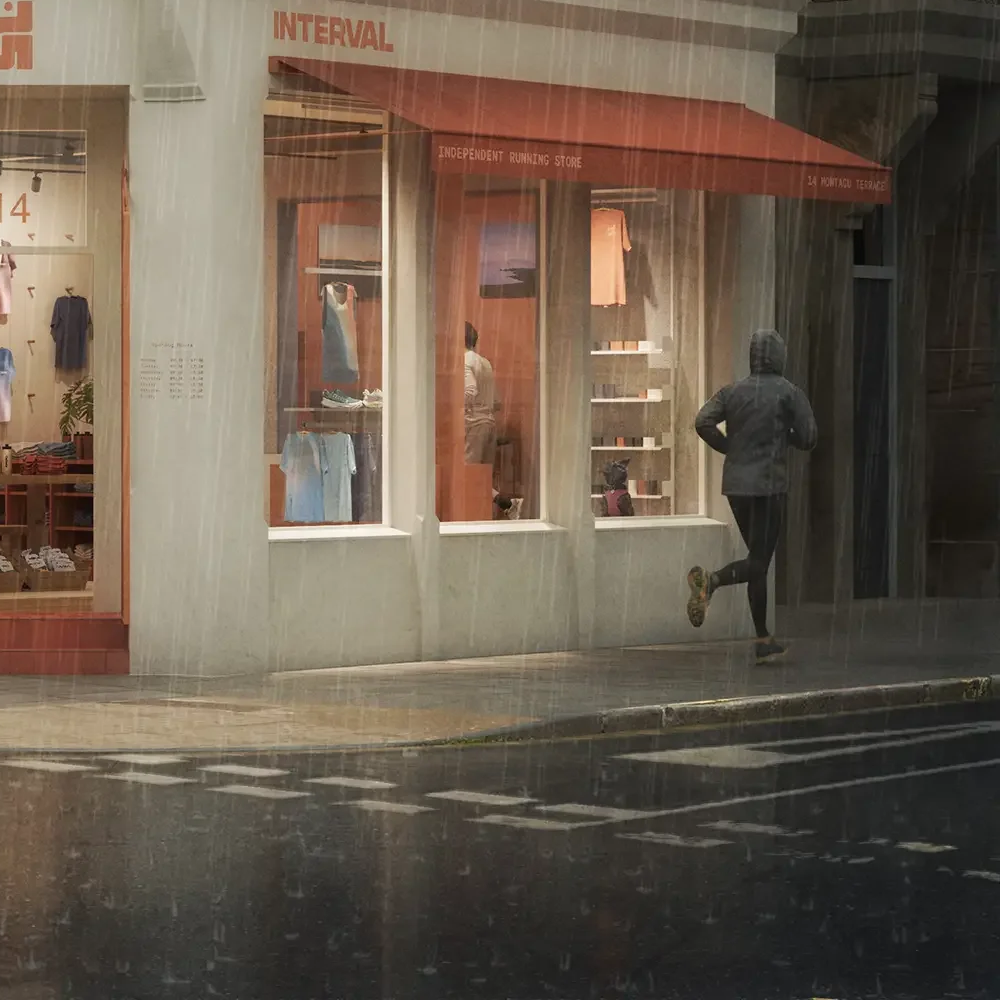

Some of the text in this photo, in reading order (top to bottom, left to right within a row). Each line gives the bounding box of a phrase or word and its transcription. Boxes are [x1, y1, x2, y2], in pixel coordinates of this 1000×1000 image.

[273, 10, 394, 52] INTERVAL
[438, 145, 582, 168] INDEPENDENT RUNNING STORE
[807, 175, 885, 191] 14 MONTAGU TERRACE
